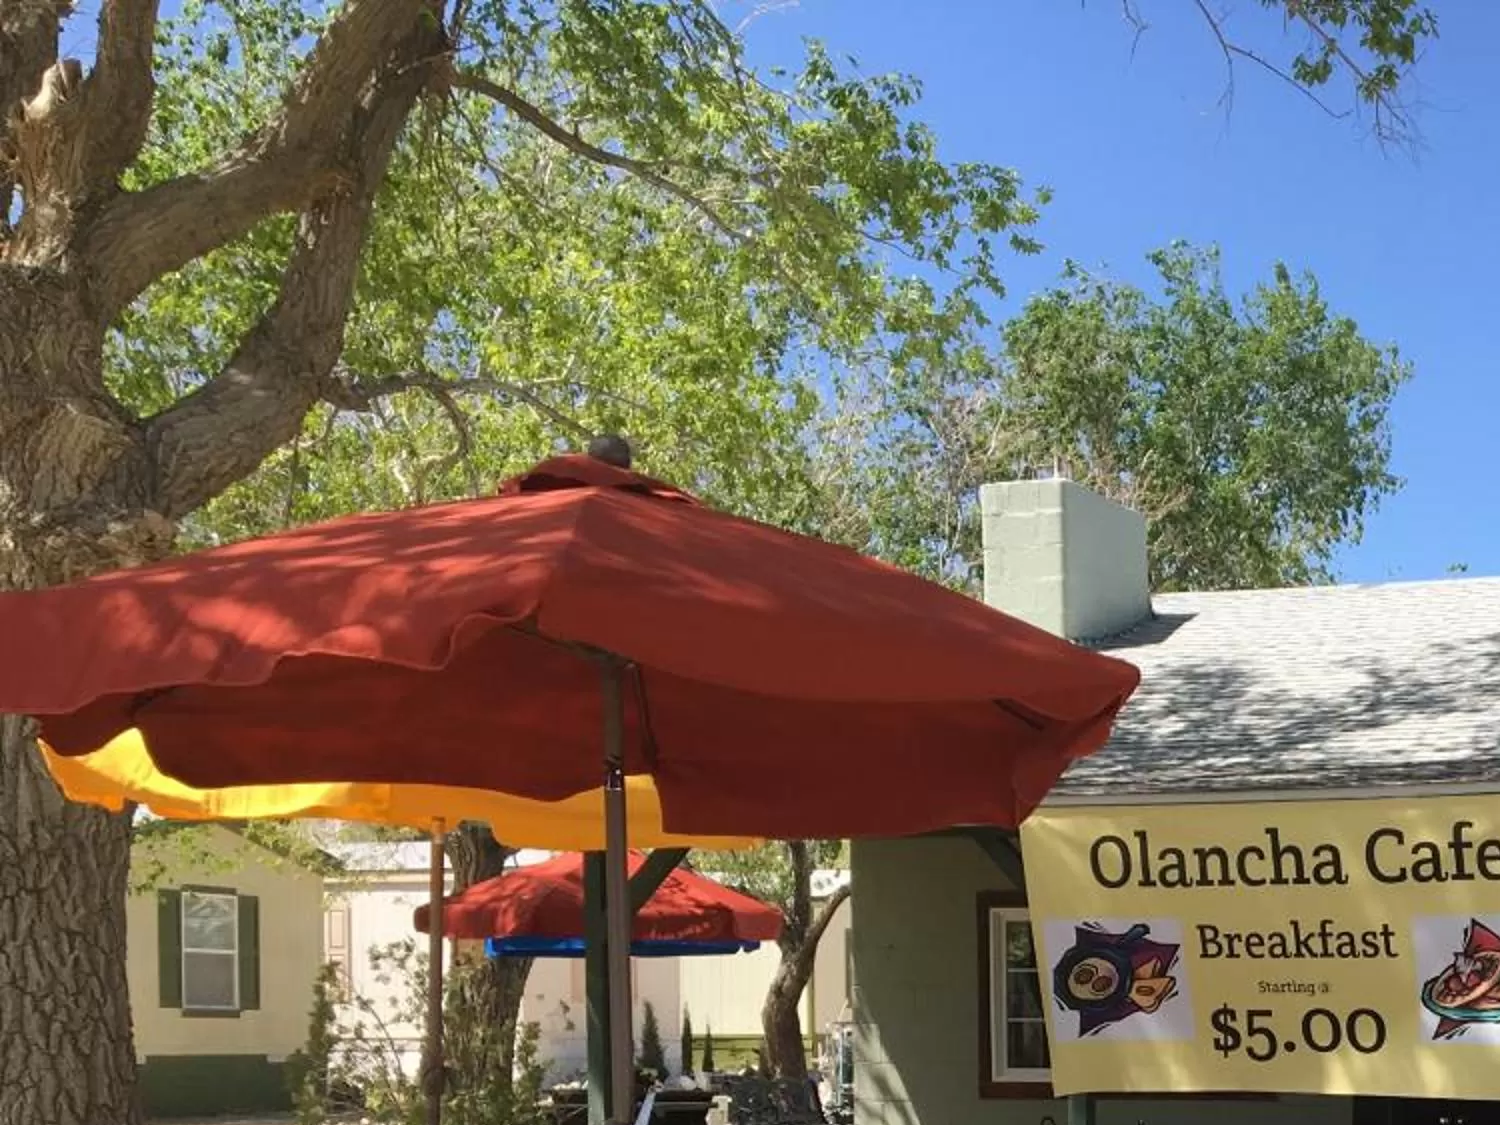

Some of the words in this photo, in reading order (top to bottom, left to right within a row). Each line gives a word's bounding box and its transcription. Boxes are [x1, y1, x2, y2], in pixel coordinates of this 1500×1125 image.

[1089, 827, 1348, 889] Olancha
[1196, 919, 1399, 961] Breakfast
[1258, 979, 1315, 997] Starting
[1210, 1004, 1387, 1062] $5.00
